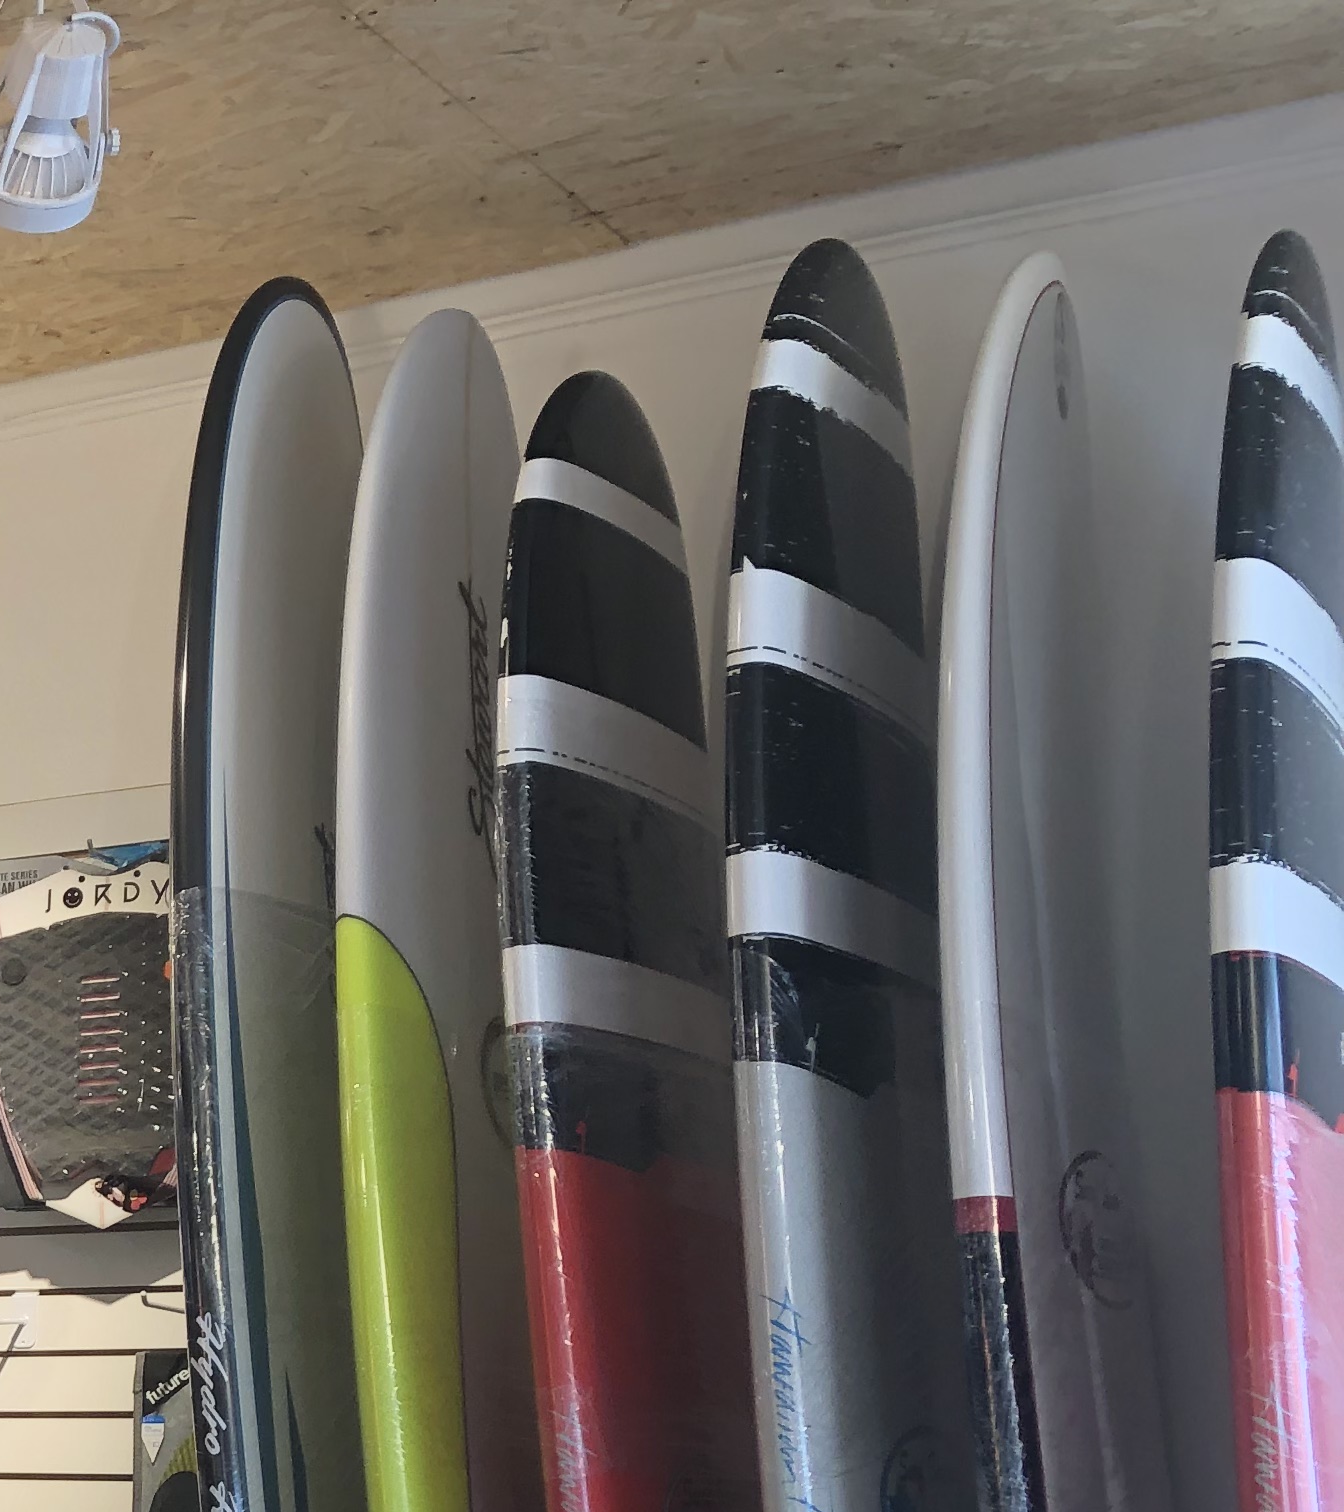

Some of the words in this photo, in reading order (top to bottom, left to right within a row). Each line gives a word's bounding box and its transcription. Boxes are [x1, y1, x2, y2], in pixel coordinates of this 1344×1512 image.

[11, 869, 38, 879] SERIES
[146, 1367, 190, 1405] future
[191, 1311, 229, 1456] Hydro
